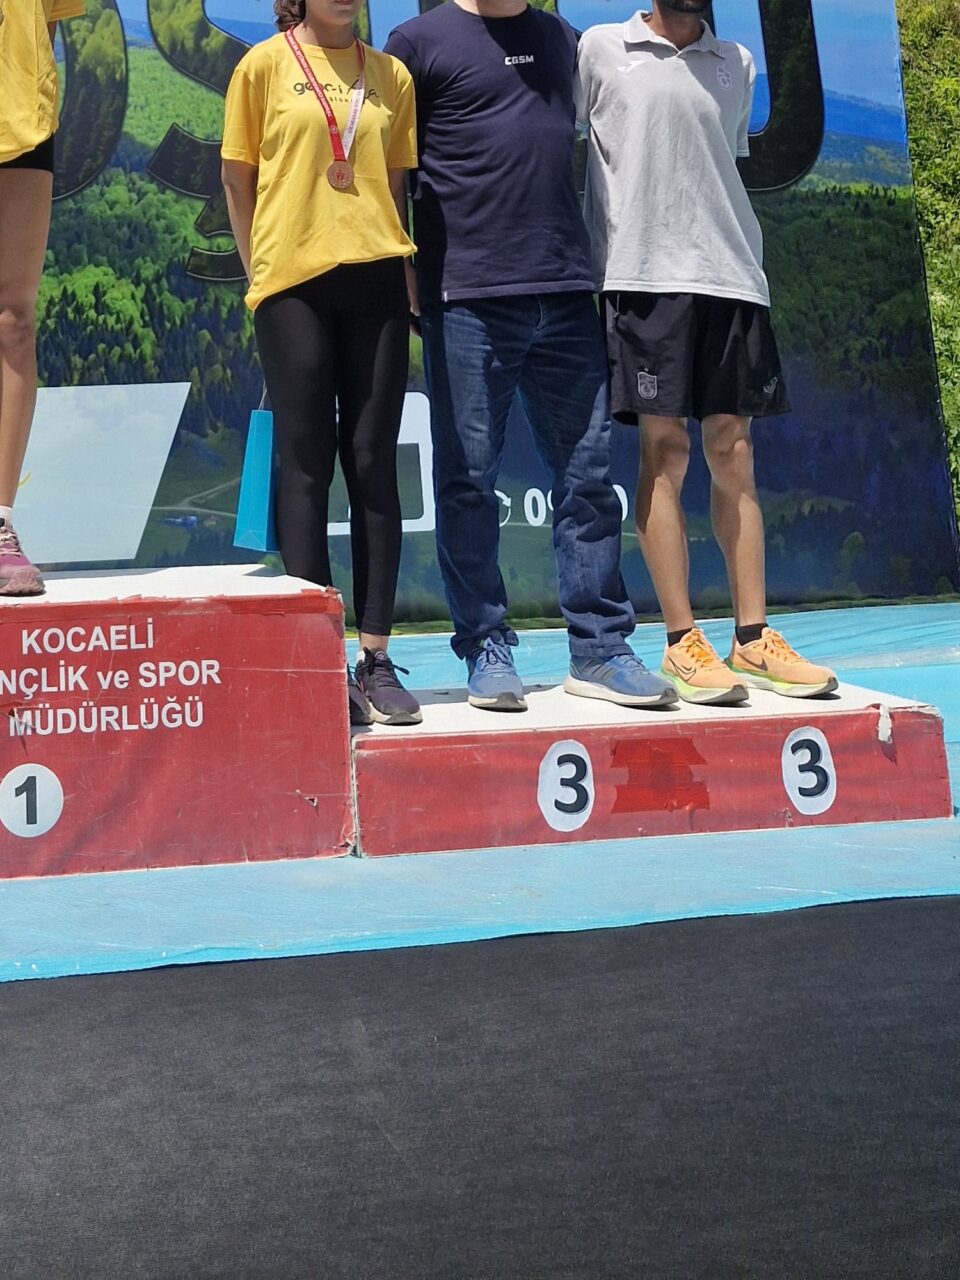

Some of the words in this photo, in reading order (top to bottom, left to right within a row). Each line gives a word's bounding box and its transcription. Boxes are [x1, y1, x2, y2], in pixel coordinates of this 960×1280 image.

[21, 618, 155, 655] KOCAELİ
[96, 669, 130, 690] ve
[137, 659, 222, 688] SPOR
[9, 695, 204, 737] MÜDÜRLÜĞÜ
[554, 753, 589, 814] 3
[791, 738, 830, 798] 3
[14, 775, 38, 826] 1
